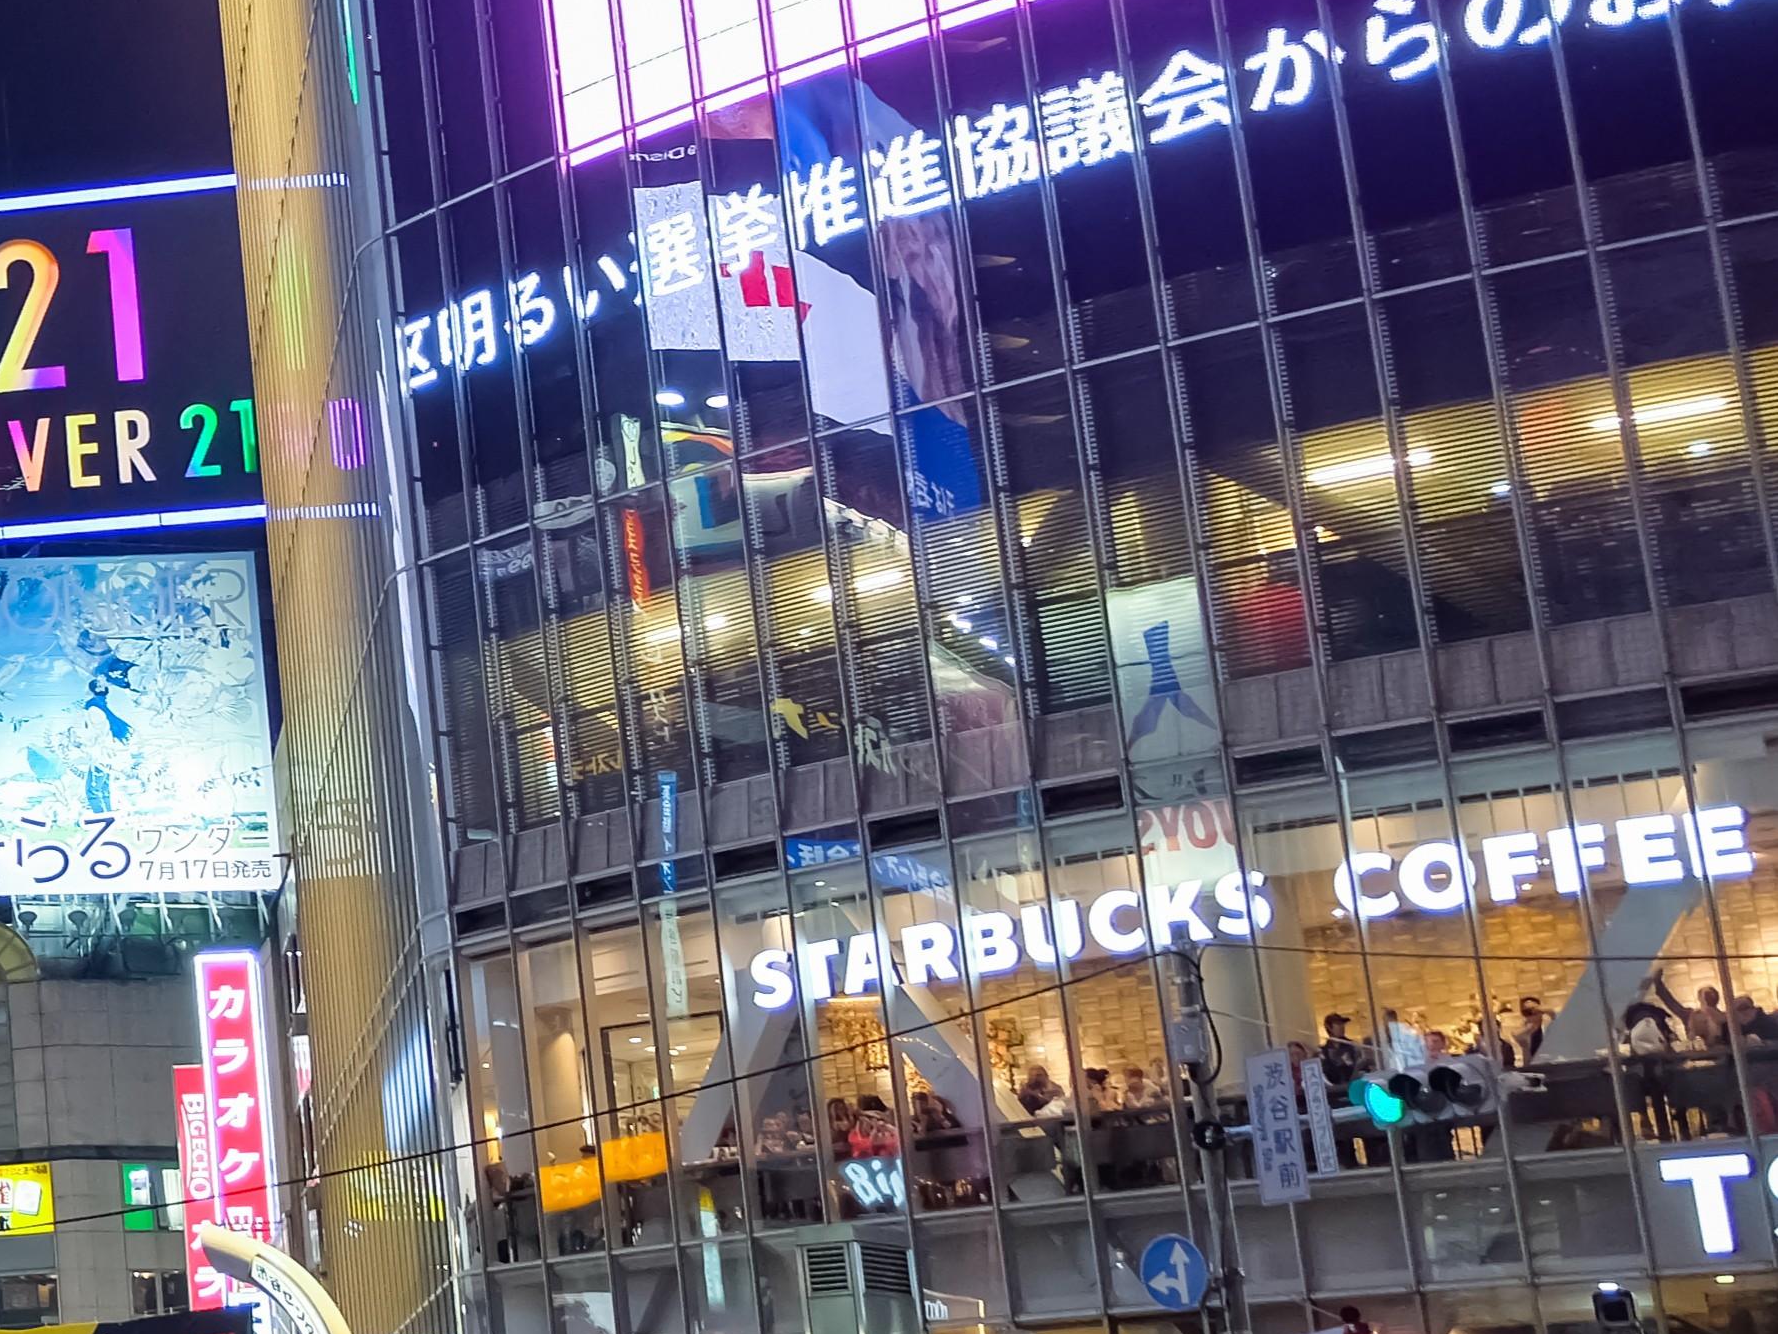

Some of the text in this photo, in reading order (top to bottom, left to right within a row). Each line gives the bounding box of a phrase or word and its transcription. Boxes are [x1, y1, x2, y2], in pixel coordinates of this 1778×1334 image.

[178, 397, 257, 478] 21
[135, 820, 269, 856] ワンダー
[138, 859, 272, 880] 7月17日発売
[749, 867, 1276, 1010] STARBUCKS
[1333, 803, 1759, 919] COFFEE
[1263, 1062, 1301, 1189] 渋谷駅前
